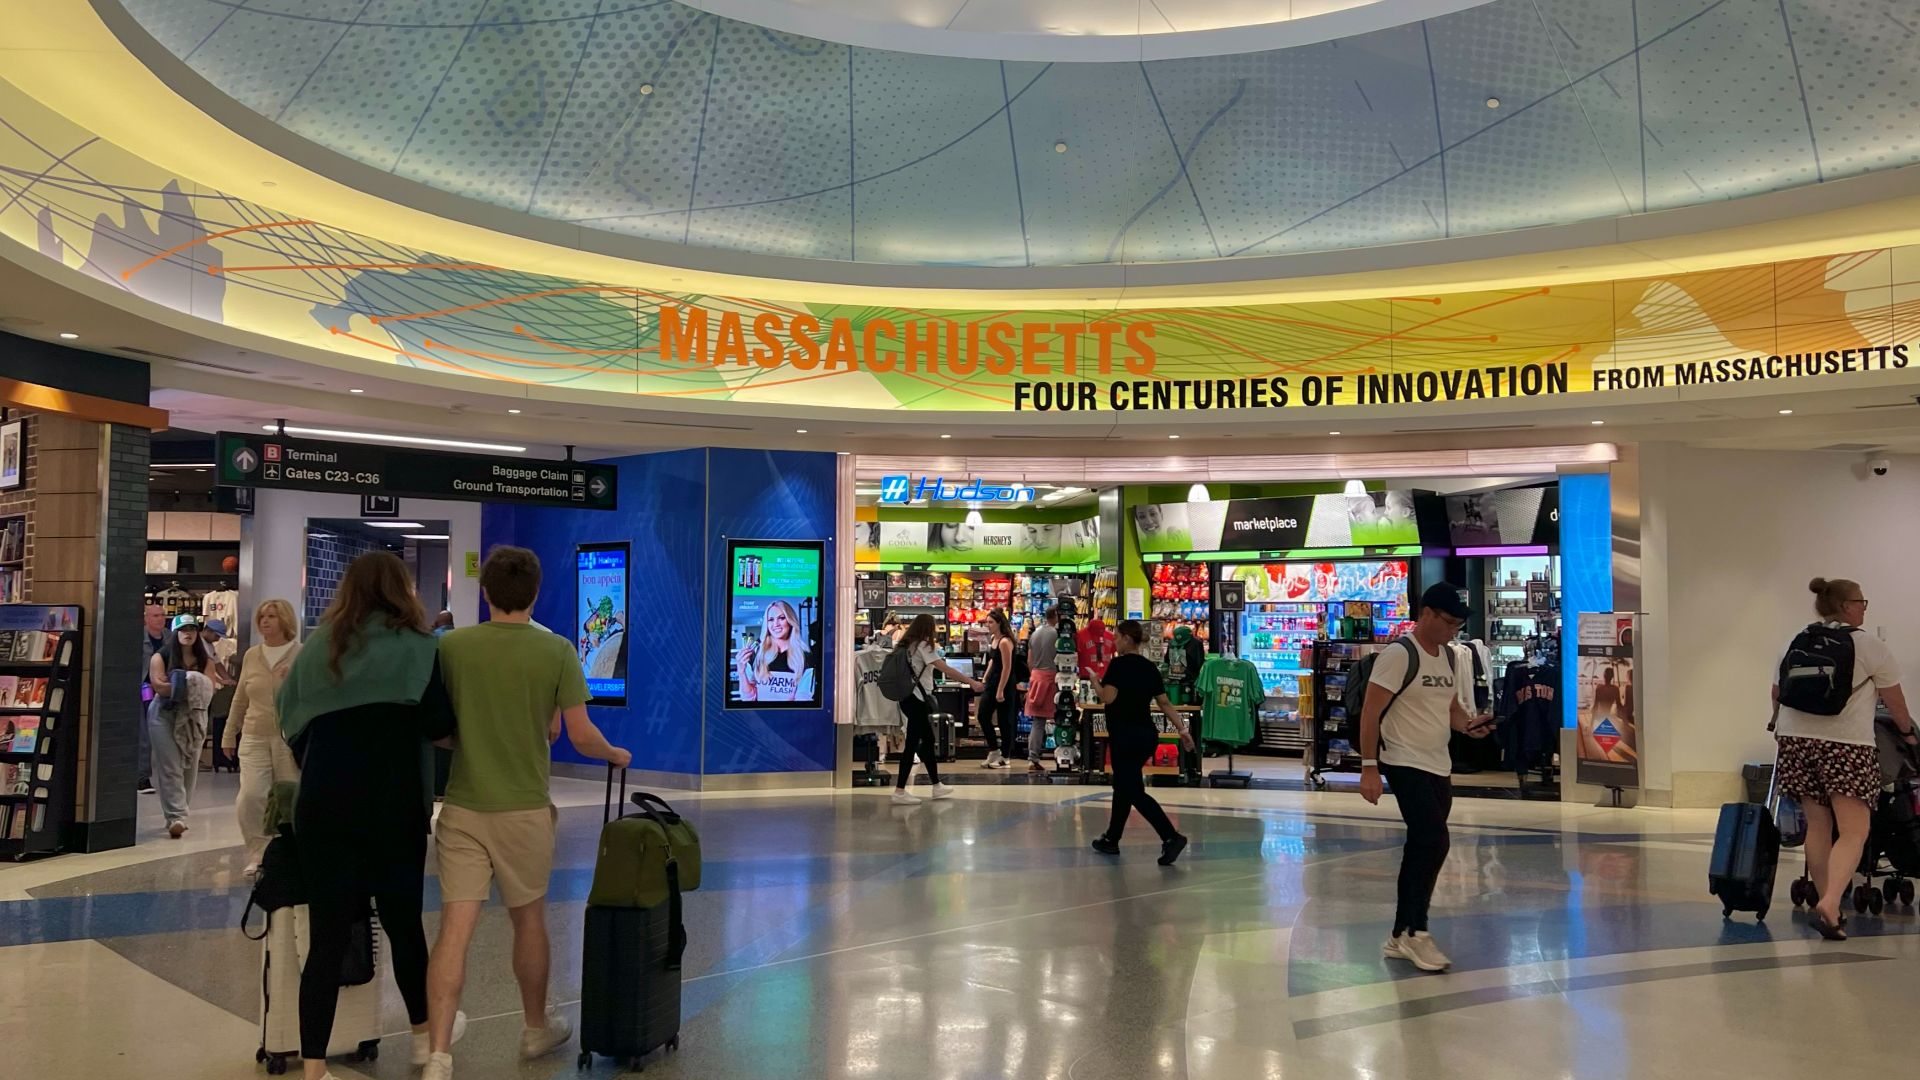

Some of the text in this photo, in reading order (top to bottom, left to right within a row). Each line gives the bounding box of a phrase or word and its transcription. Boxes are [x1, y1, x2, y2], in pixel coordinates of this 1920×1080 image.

[659, 305, 1157, 375] MASSACHUSETTS
[1593, 344, 1908, 391] FROM MASSACHUSETTS
[1014, 362, 1569, 411] FOUR CENTURIES OF INNOVATION
[267, 447, 337, 463] B Terminal
[285, 467, 380, 485] Gates C23-C36
[492, 465, 569, 481] Baggage Claim
[453, 479, 569, 498] Ground Transportation
[914, 476, 1036, 502] Hudson
[1233, 516, 1298, 533] marketplace
[582, 573, 596, 585] bon
[863, 670, 882, 684] BOS
[1422, 675, 1454, 688] 2XU
